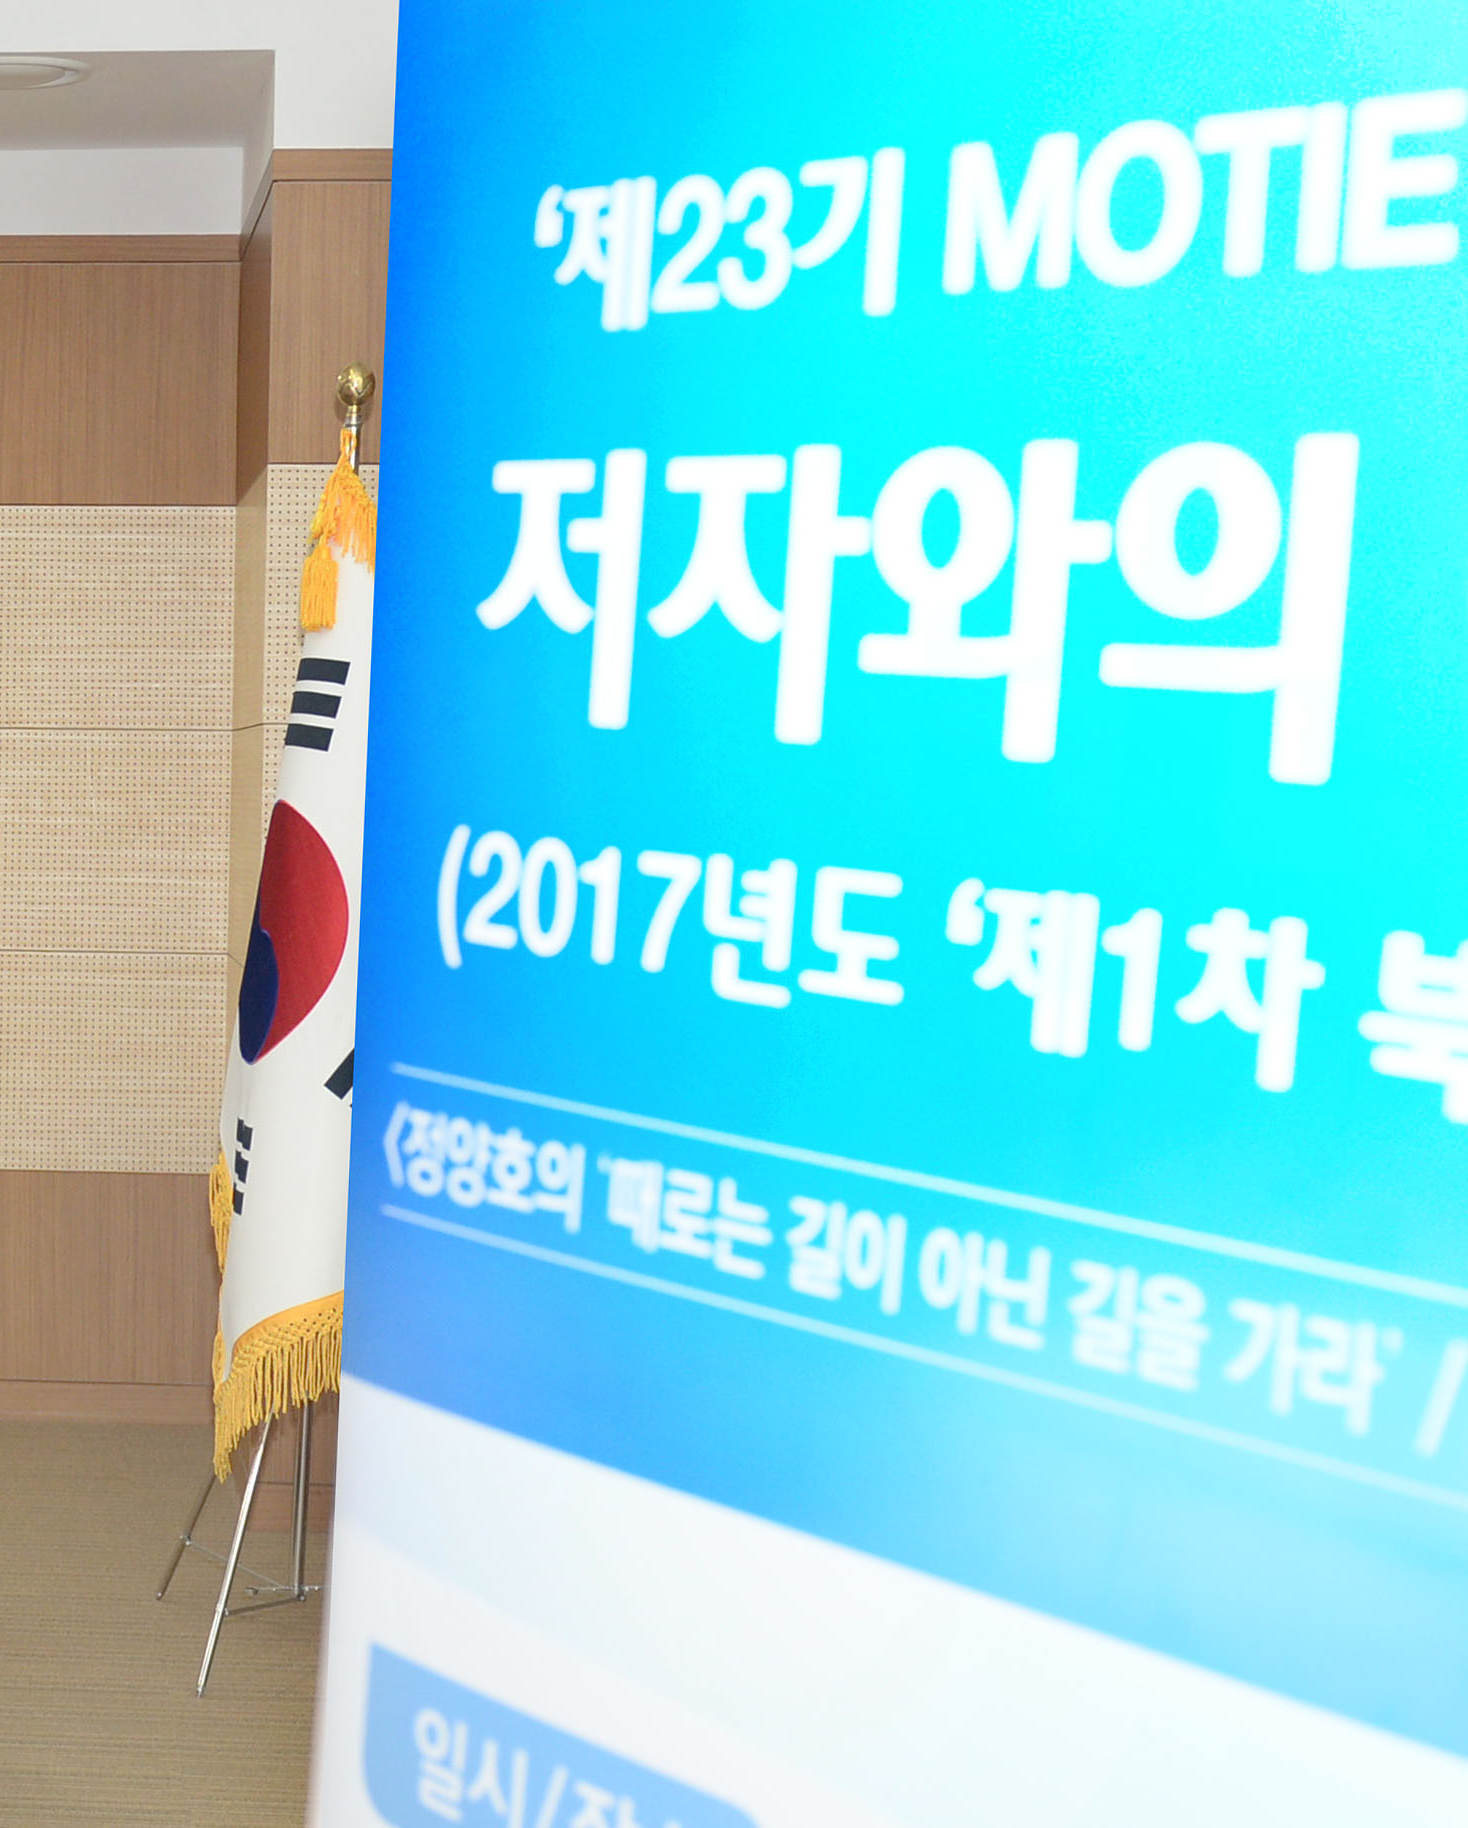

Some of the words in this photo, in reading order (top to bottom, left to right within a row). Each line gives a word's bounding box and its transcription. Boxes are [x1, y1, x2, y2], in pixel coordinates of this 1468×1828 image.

[535, 147, 905, 331] ‘제23기
[943, 88, 1468, 294] MOTIE
[477, 432, 1359, 785] 저자와의
[438, 825, 903, 1008] (2017년도
[946, 879, 1325, 1092] ‘제1차
[786, 1196, 907, 1315] 길이
[919, 1227, 1052, 1352] 아닌
[1068, 1259, 1210, 1392] 길을
